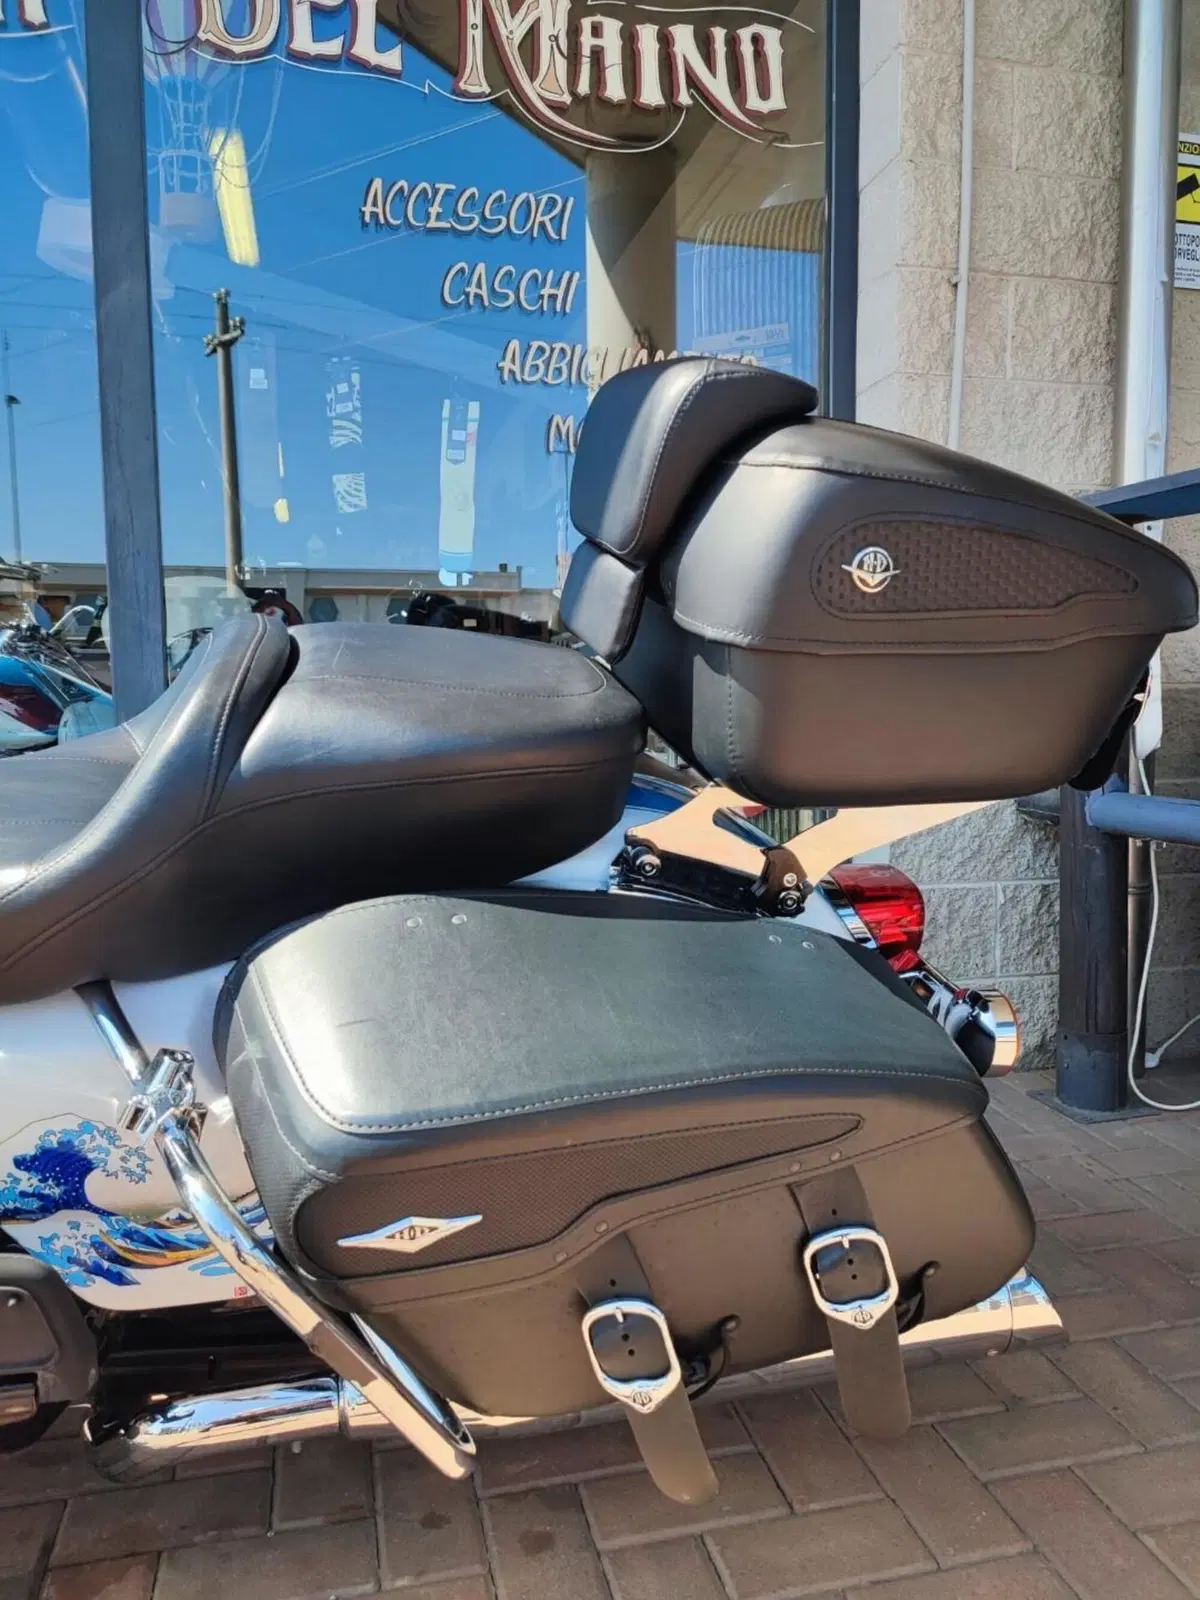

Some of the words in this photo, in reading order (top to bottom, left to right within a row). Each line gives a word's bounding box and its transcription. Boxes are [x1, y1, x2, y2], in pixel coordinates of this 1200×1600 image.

[361, 177, 574, 242] ACCESSORI
[442, 261, 580, 314] CASCHI
[546, 414, 584, 456] M
